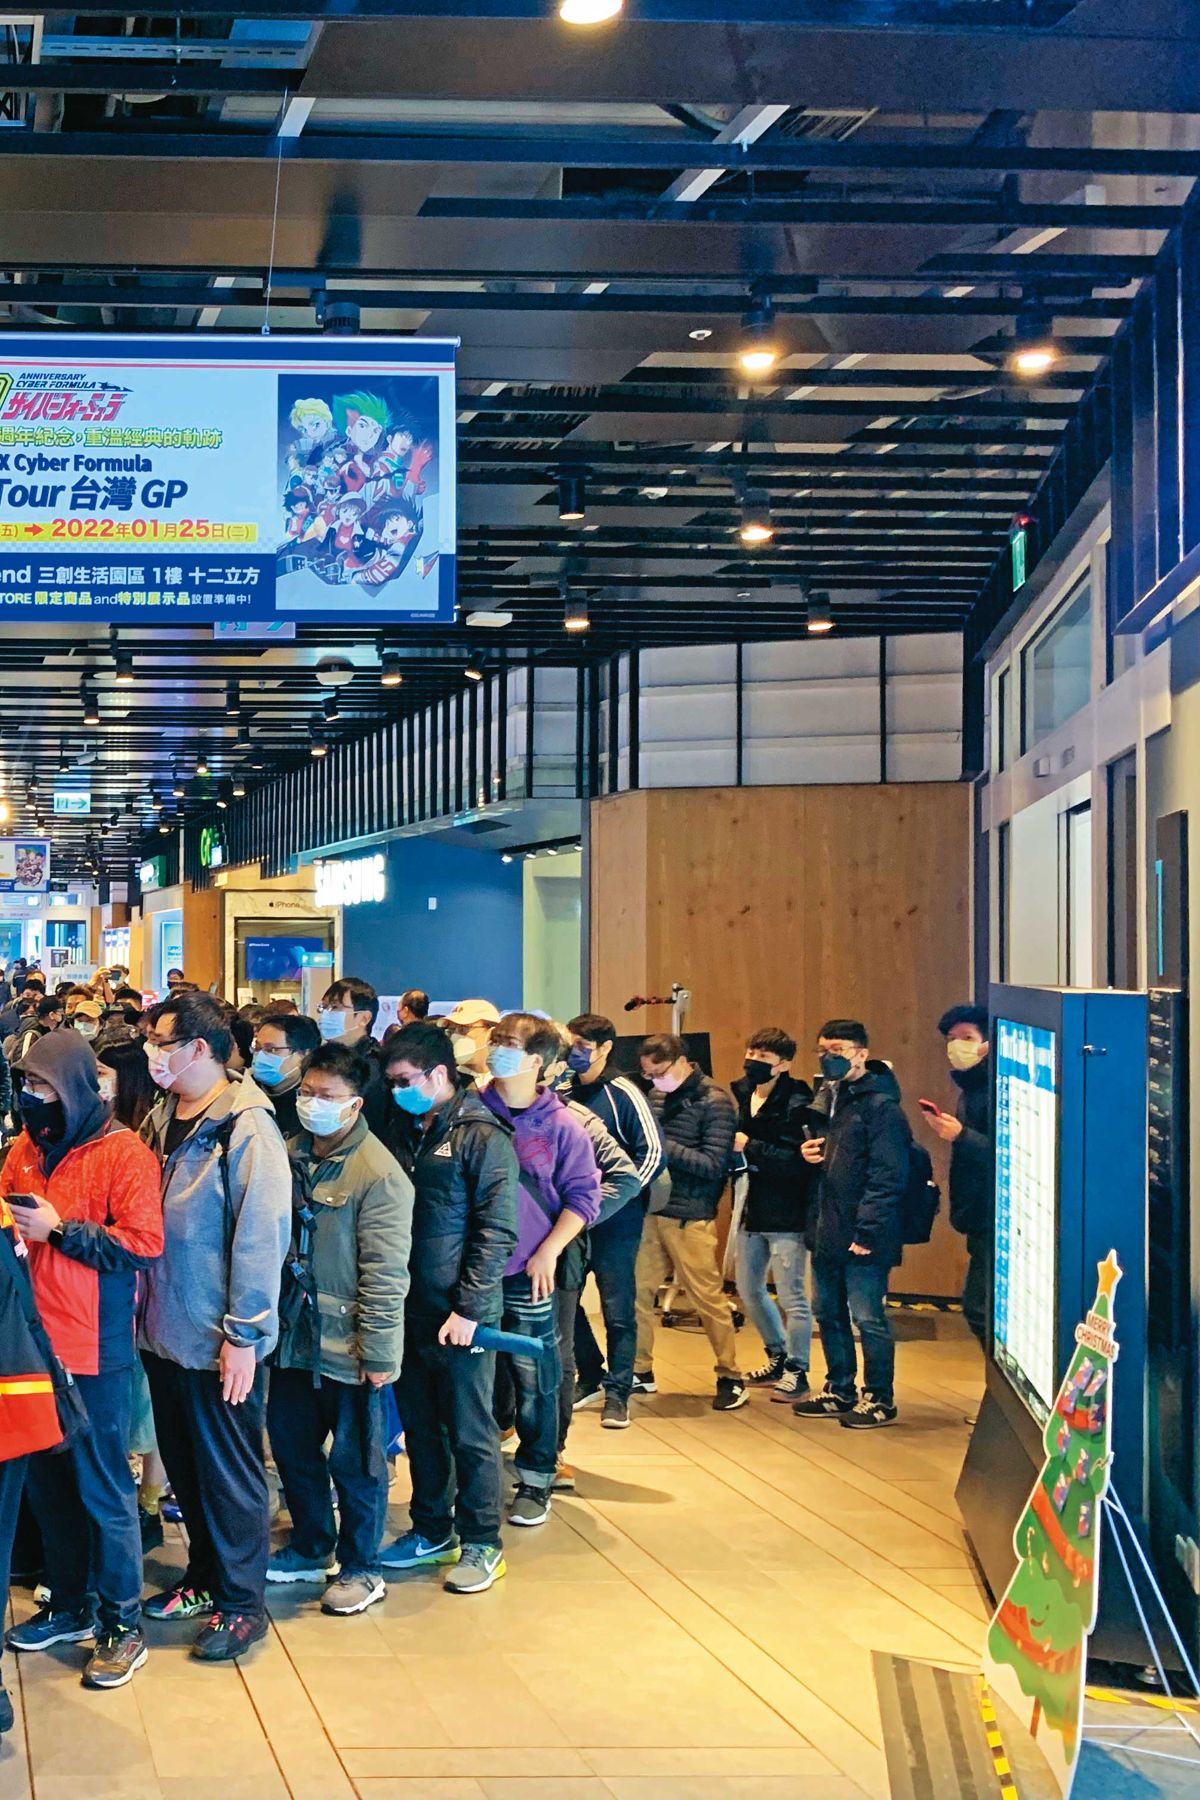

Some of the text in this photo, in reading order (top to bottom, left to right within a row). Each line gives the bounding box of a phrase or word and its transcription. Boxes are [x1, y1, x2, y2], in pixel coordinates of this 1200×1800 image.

[19, 372, 86, 381] ANNIVERSARY
[49, 381, 96, 389] FORMULA
[13, 453, 70, 476] Cyber
[73, 454, 153, 473] Formula
[68, 475, 137, 511] 台灣
[141, 479, 188, 509] GP
[37, 566, 145, 585] 三創生活園區
[152, 567, 183, 585] 1樓
[188, 566, 261, 585] 十二立方
[315, 854, 386, 908] SAMSUNG
[1087, 1313, 1112, 1337] MERRY
[1077, 1325, 1116, 1359] CHRISTMAS
